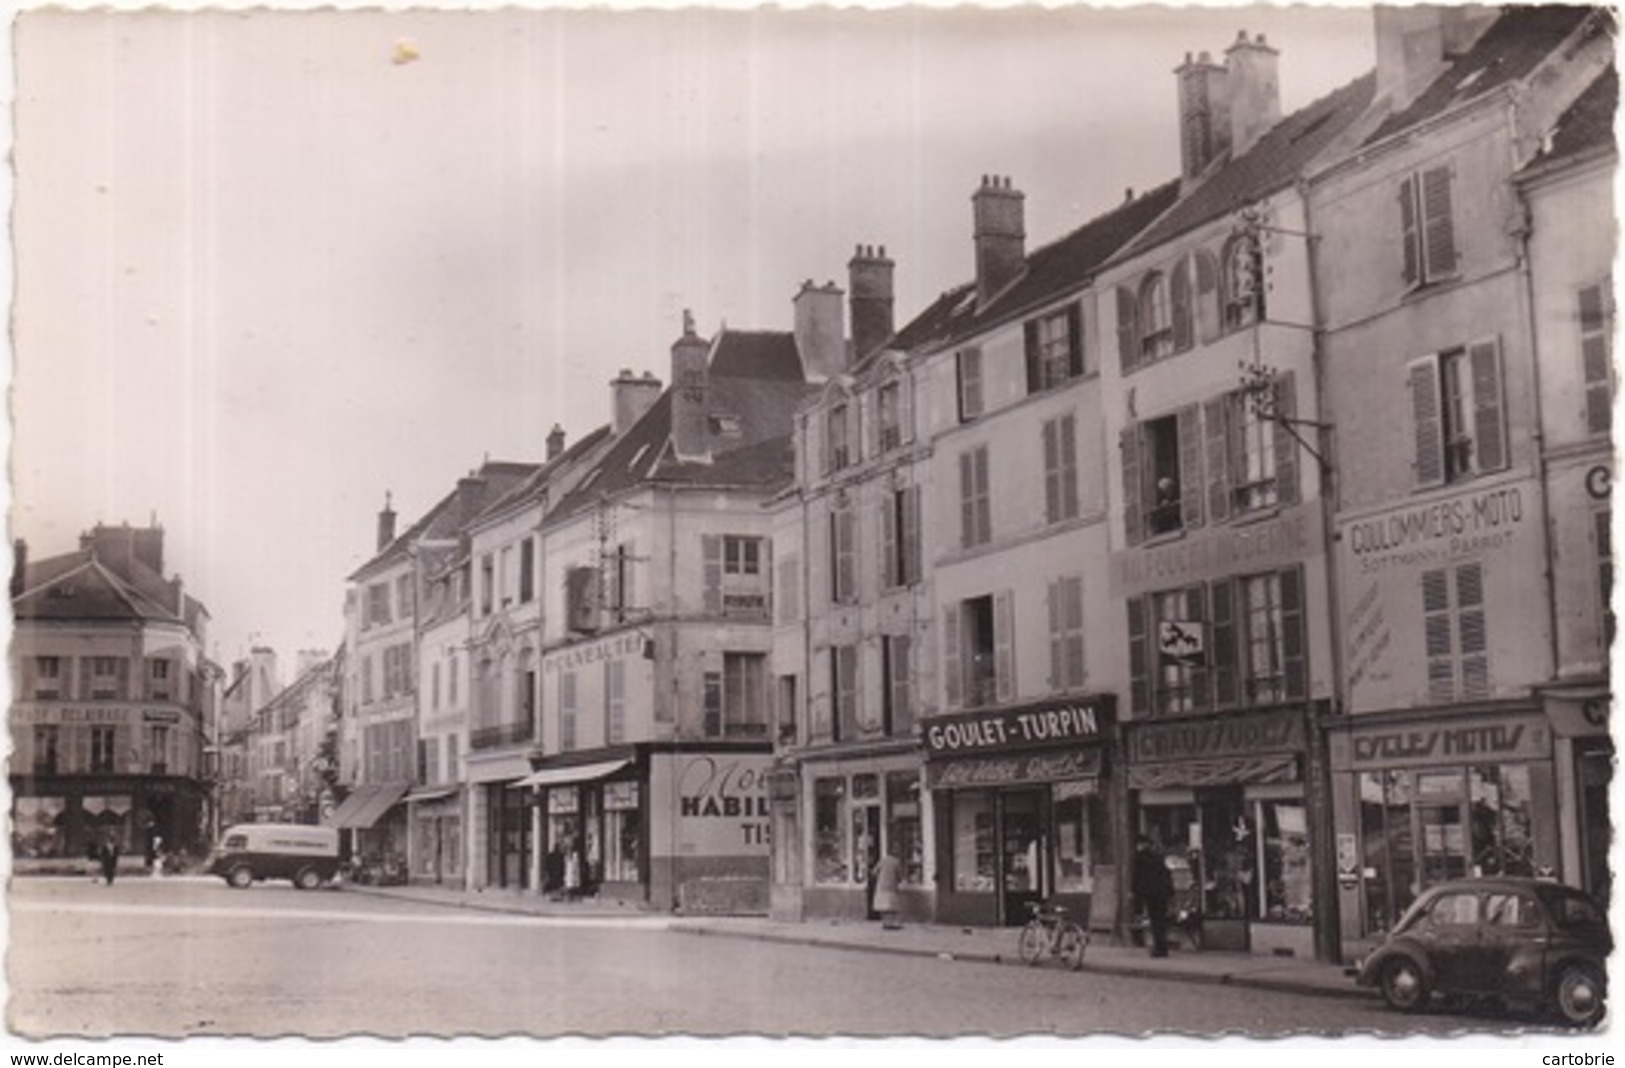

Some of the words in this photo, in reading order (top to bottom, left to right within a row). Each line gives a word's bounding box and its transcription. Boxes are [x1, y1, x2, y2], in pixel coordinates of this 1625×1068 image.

[928, 707, 1098, 750] GOULET-TURPIN
[1354, 731, 1440, 761] CYCLES
[1443, 723, 1525, 755] MOTOS
